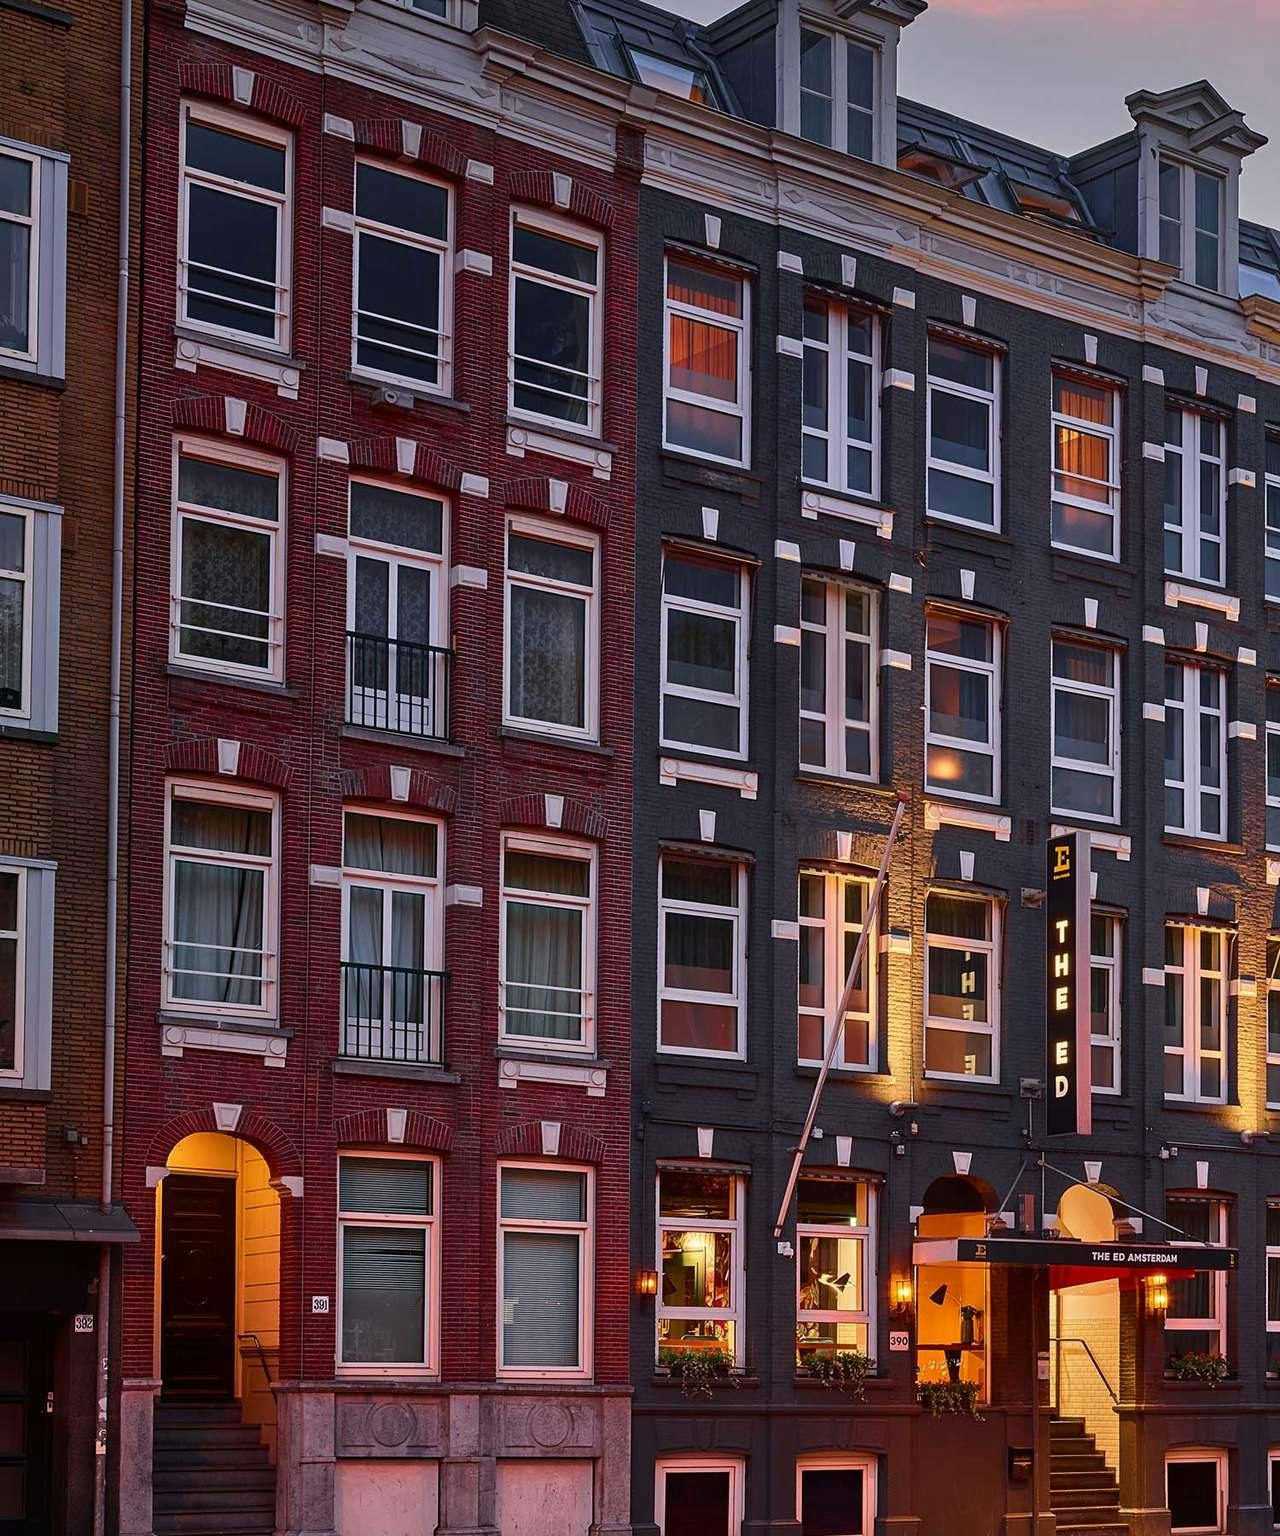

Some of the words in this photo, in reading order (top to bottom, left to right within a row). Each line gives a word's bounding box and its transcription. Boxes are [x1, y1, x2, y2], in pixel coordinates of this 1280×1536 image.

[1053, 845, 1070, 873] E
[1055, 919, 1069, 1011] THE
[1055, 1041, 1069, 1098] ED
[1092, 1252, 1110, 1261] THE
[1113, 1253, 1125, 1261] ED
[1128, 1254, 1178, 1263] AMSTERDAM
[314, 1299, 327, 1311] 391
[76, 1317, 92, 1329] 392
[891, 1336, 908, 1345] 390
